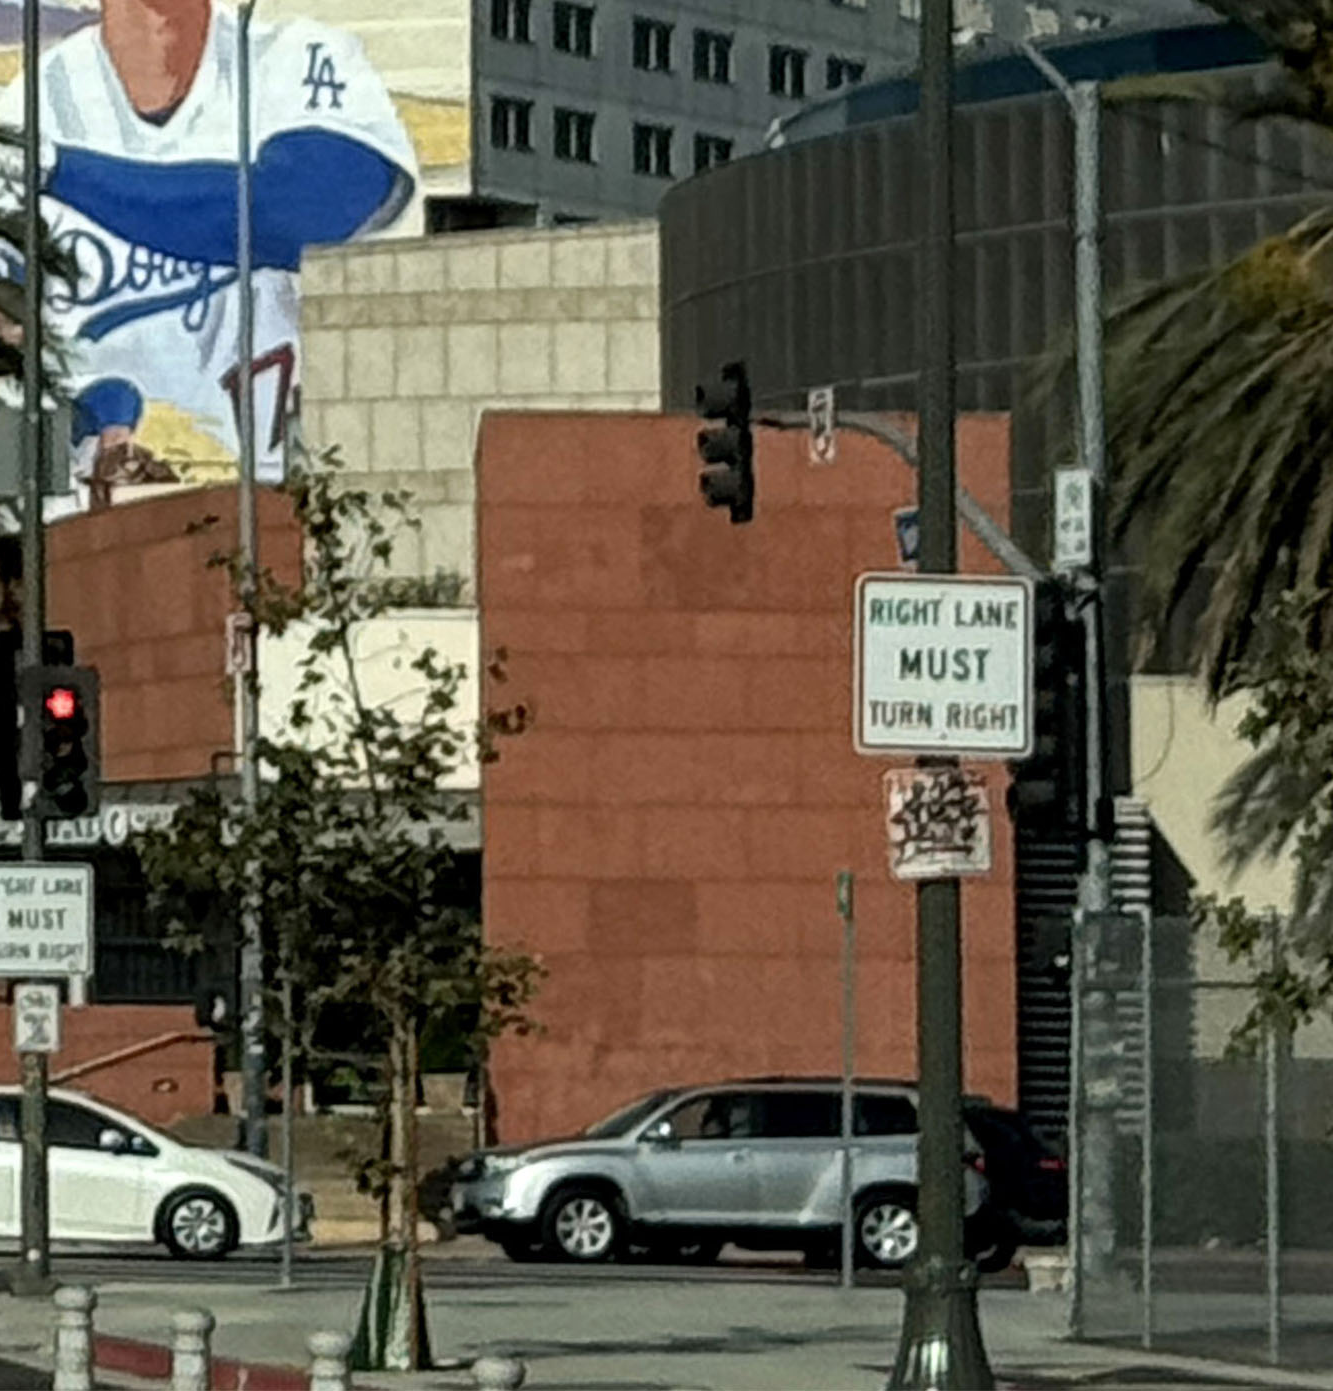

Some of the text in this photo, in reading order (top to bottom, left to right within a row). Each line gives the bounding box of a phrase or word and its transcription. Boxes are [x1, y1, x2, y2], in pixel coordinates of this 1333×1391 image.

[301, 42, 346, 109] LA
[869, 597, 1019, 629] RIGHT LANE
[898, 647, 990, 683] MUST
[869, 699, 1019, 732] TURN RIGHT
[7, 908, 68, 931] MUST
